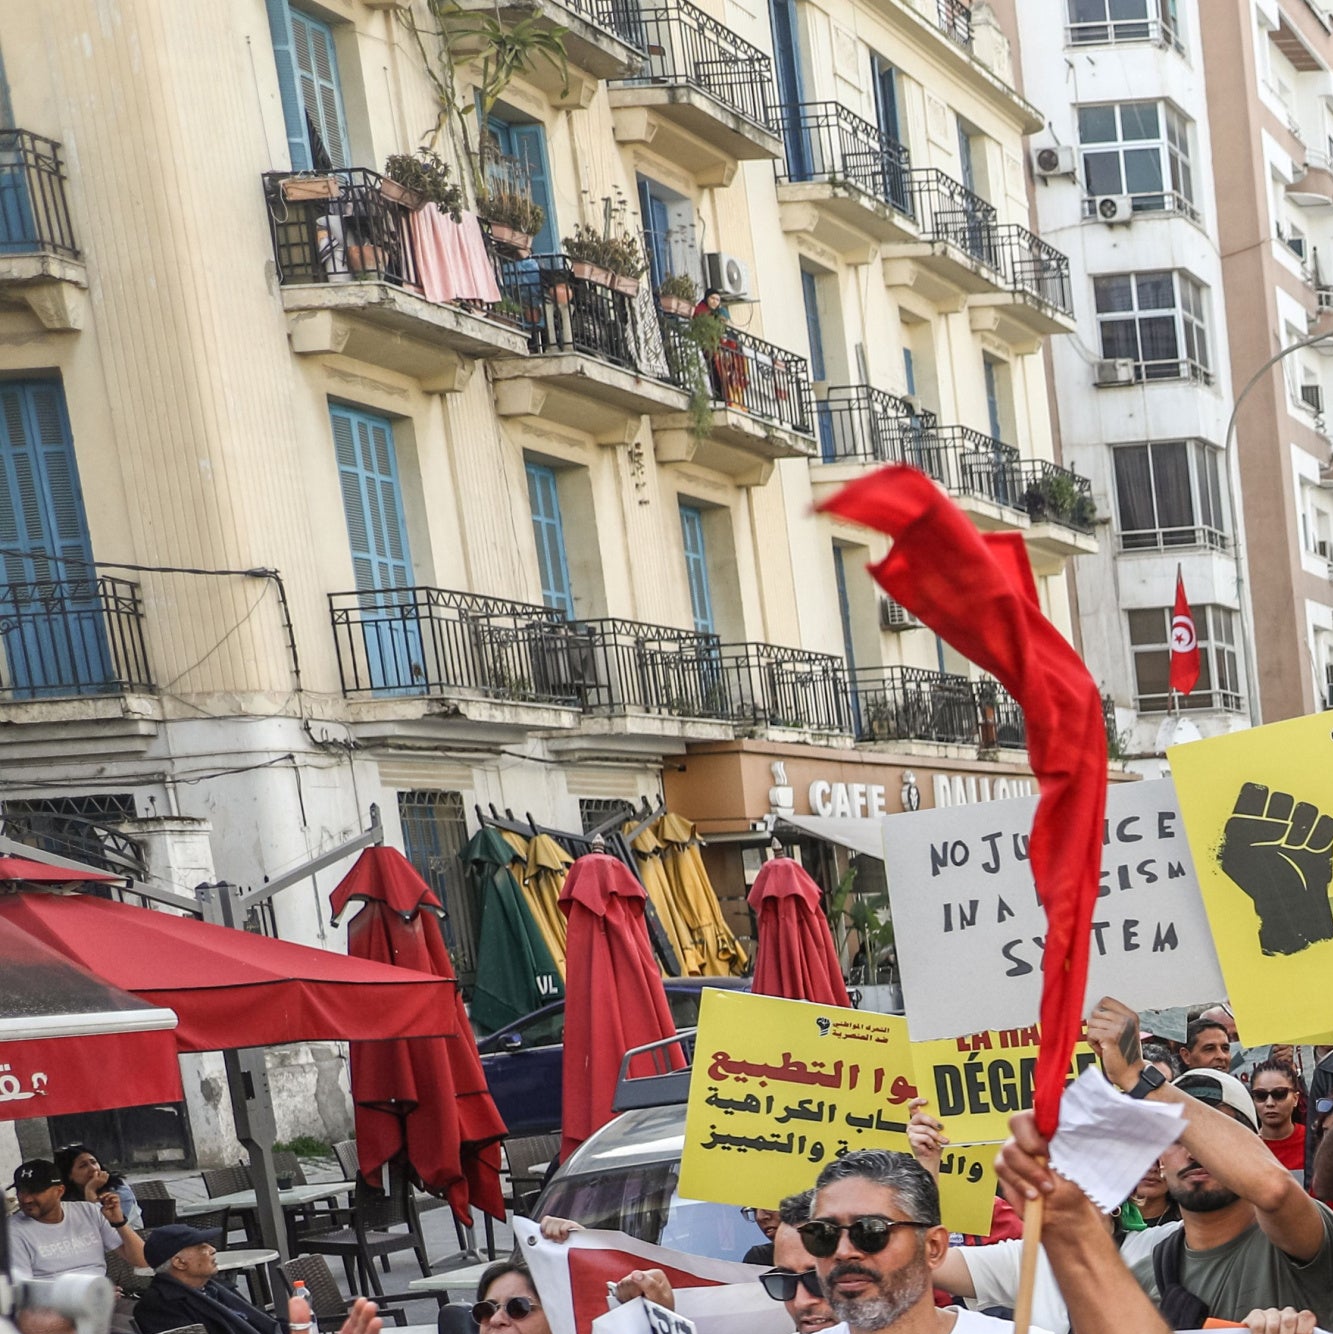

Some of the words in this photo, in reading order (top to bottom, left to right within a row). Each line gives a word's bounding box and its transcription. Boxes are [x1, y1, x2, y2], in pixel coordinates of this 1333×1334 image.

[809, 780, 886, 817] CAFE
[929, 839, 969, 877] NO
[980, 811, 1176, 874] JUICE
[943, 900, 978, 932] IN
[997, 895, 1015, 924] A
[1001, 919, 1179, 977] SYTEM
[832, 1030, 873, 1042] العنصرية
[875, 1034, 889, 1044] ضد
[708, 1051, 860, 1090] التطبيع
[705, 1086, 836, 1123] الكراهية
[700, 1124, 825, 1163] والتمييز
